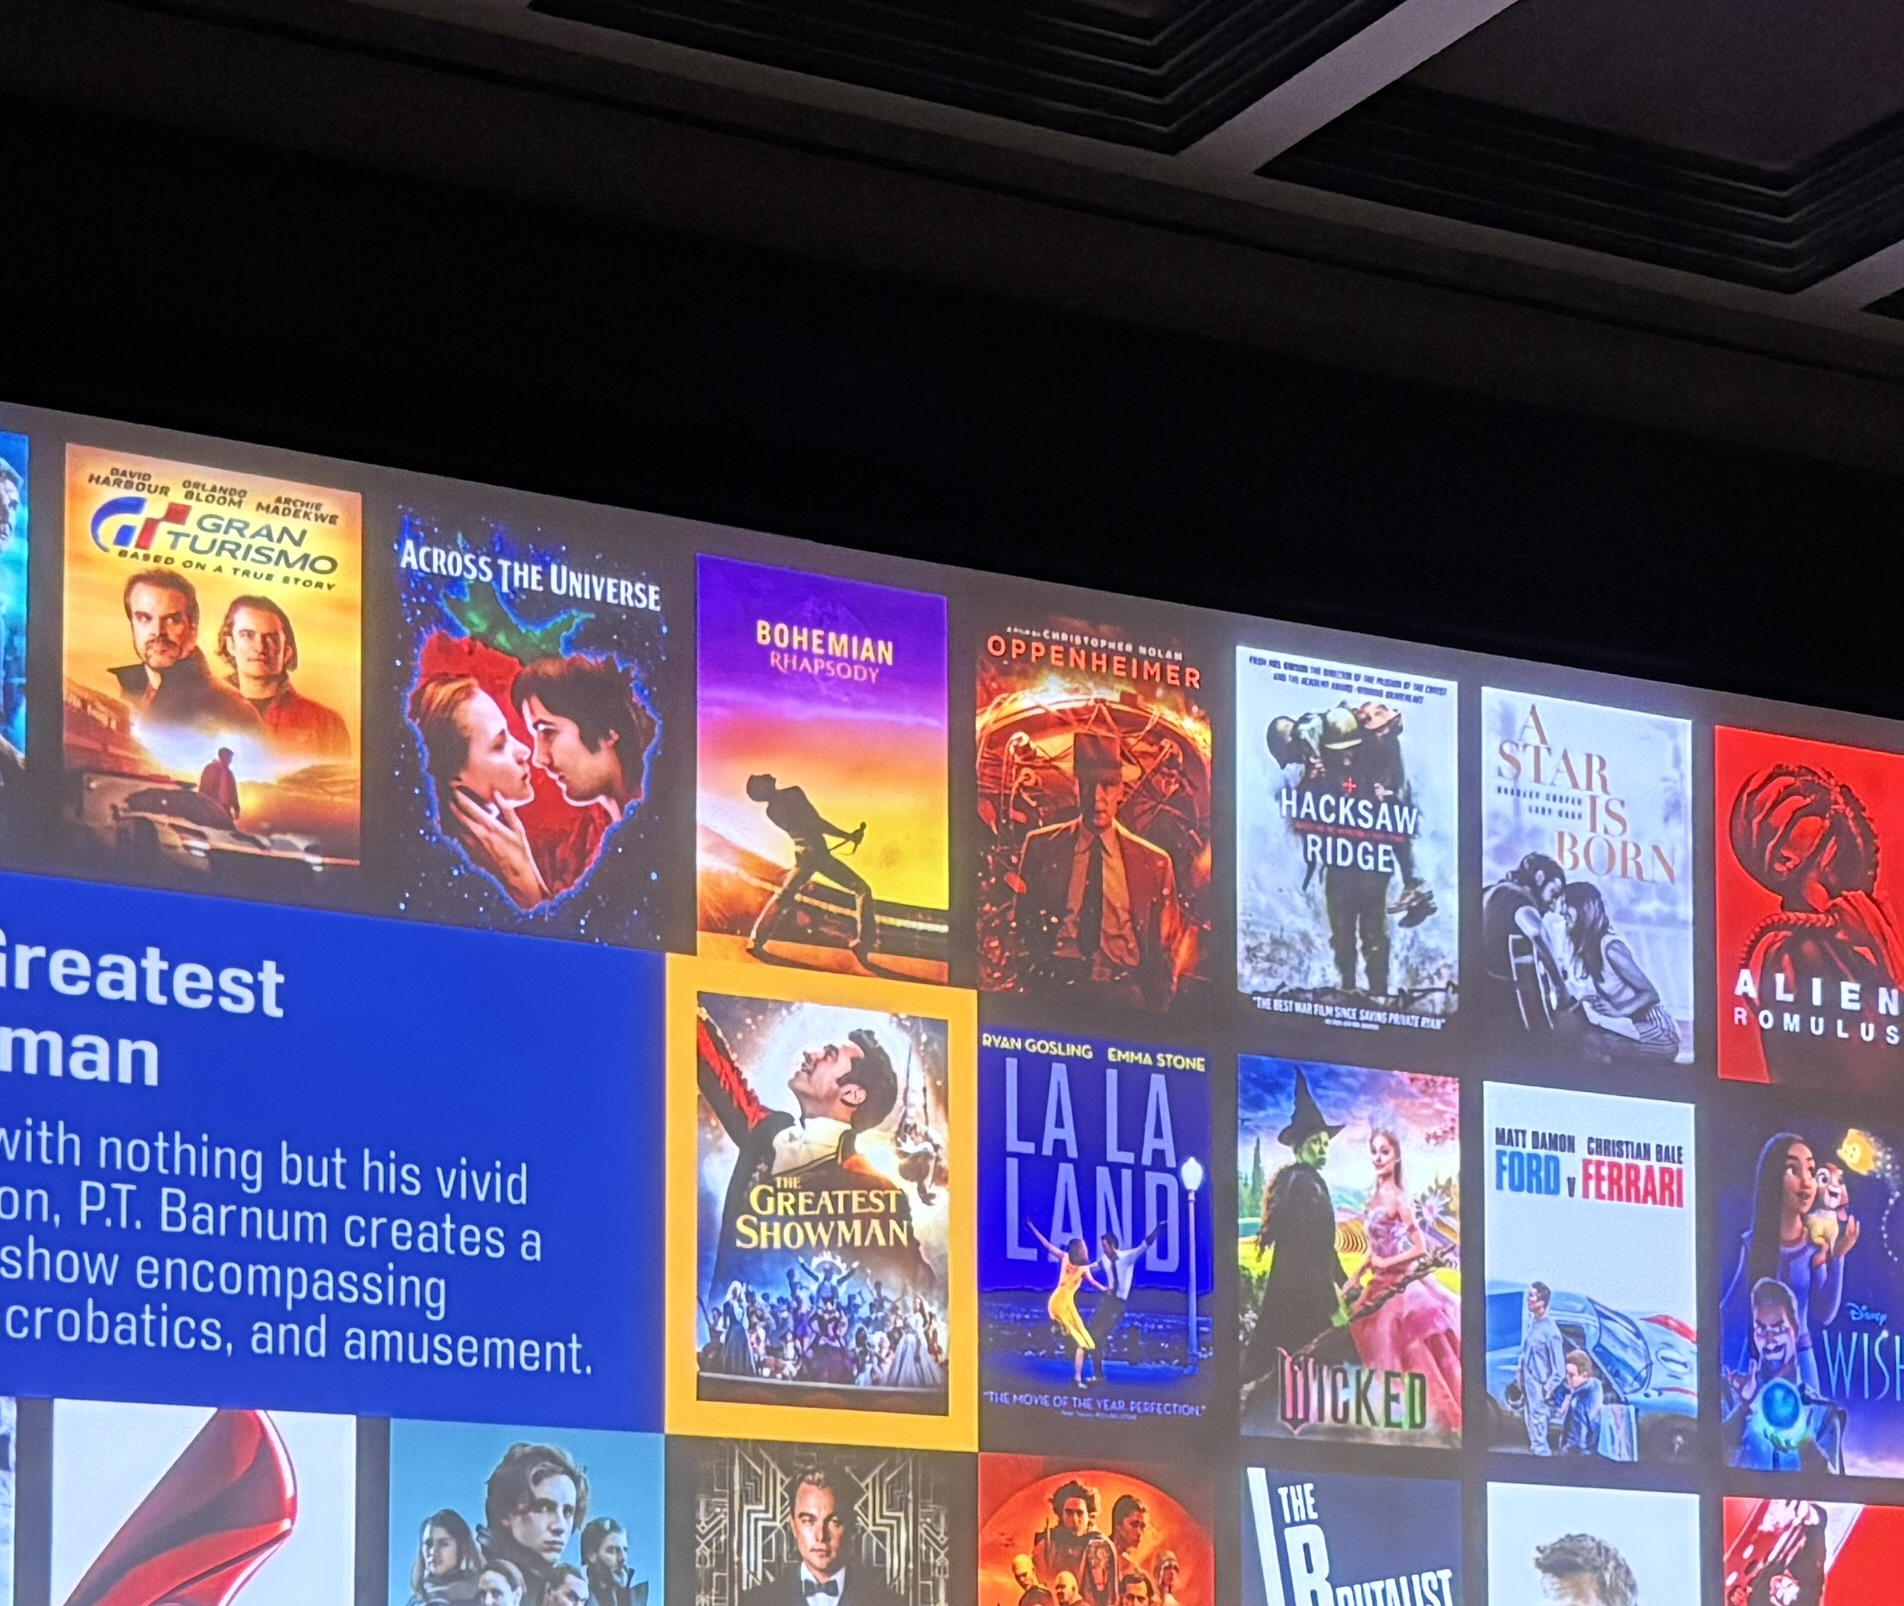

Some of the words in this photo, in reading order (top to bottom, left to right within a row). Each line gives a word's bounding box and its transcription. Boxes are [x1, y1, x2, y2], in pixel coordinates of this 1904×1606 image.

[88, 473, 171, 497] HARBOUR
[184, 490, 243, 509] BLOOM
[255, 502, 339, 525] MADEKWE
[110, 467, 152, 481] DAVID
[182, 479, 248, 498] ORLANDO
[274, 495, 323, 511] ARCHIE
[196, 513, 308, 547] GRAN
[117, 550, 175, 565] BASED
[182, 560, 207, 571] ON
[213, 565, 224, 573] A
[232, 567, 274, 582] TRUE
[281, 576, 337, 591] STORY
[166, 530, 338, 575] TURISMO
[400, 539, 493, 583] ACROSS
[498, 558, 544, 593] THE
[550, 563, 661, 612] UNIVERSE
[755, 619, 894, 666] BOHEMIAN
[987, 635, 1201, 689] OPPENHEIMER
[1043, 629, 1133, 653] CHRISTOPHER
[1138, 645, 1183, 661] NOLAN
[770, 650, 881, 685] RHAPSODY
[1517, 704, 1549, 746] A
[1497, 740, 1610, 795] STAR
[1281, 788, 1418, 835] HACKSAW
[1589, 795, 1627, 838] IS
[1307, 834, 1393, 873] RIDGE
[1557, 831, 1676, 885] BORN
[1273, 998, 1293, 1013] BEST
[1734, 969, 1900, 1016] ALIEN
[1734, 1007, 1900, 1045] ROMULUS
[982, 1033, 1021, 1050] RYAN
[1025, 1038, 1093, 1059] GOSLING
[1107, 1048, 1153, 1065] EMMA
[1156, 1053, 1206, 1072] STONE
[1005, 1057, 1078, 1159] LA
[1106, 1068, 1176, 1168] LA
[1495, 1127, 1527, 1148] MATT
[1531, 1130, 1575, 1153] DAMON
[1587, 1136, 1651, 1161] CHRISTIAN
[1655, 1144, 1683, 1164] BALE
[100, 1131, 262, 1194] nothing
[281, 1140, 347, 1190] but
[363, 1148, 421, 1196] his
[436, 1157, 527, 1205] vivid
[775, 1176, 801, 1189] THE
[1496, 1149, 1560, 1195] FORD
[1582, 1158, 1684, 1208] FERRARI
[81, 1180, 142, 1230] P.T.
[161, 1187, 327, 1244] Barnum
[344, 1213, 505, 1259] creates
[521, 1228, 541, 1262] a
[749, 1184, 902, 1216] GREATEST
[1006, 1157, 1179, 1273] LAND
[735, 1214, 909, 1249] SHOWMAN
[0, 1235, 120, 1286] show
[136, 1254, 446, 1321] encompassing
[1846, 1302, 1888, 1326] Disney
[251, 1313, 327, 1359] and
[343, 1326, 592, 1375] amusement.
[1012, 1394, 1049, 1407] MOVIE
[1053, 1396, 1068, 1408] OF
[1072, 1397, 1093, 1410] THE
[1279, 1356, 1427, 1432] WICKED
[1277, 1483, 1318, 1523] THE
